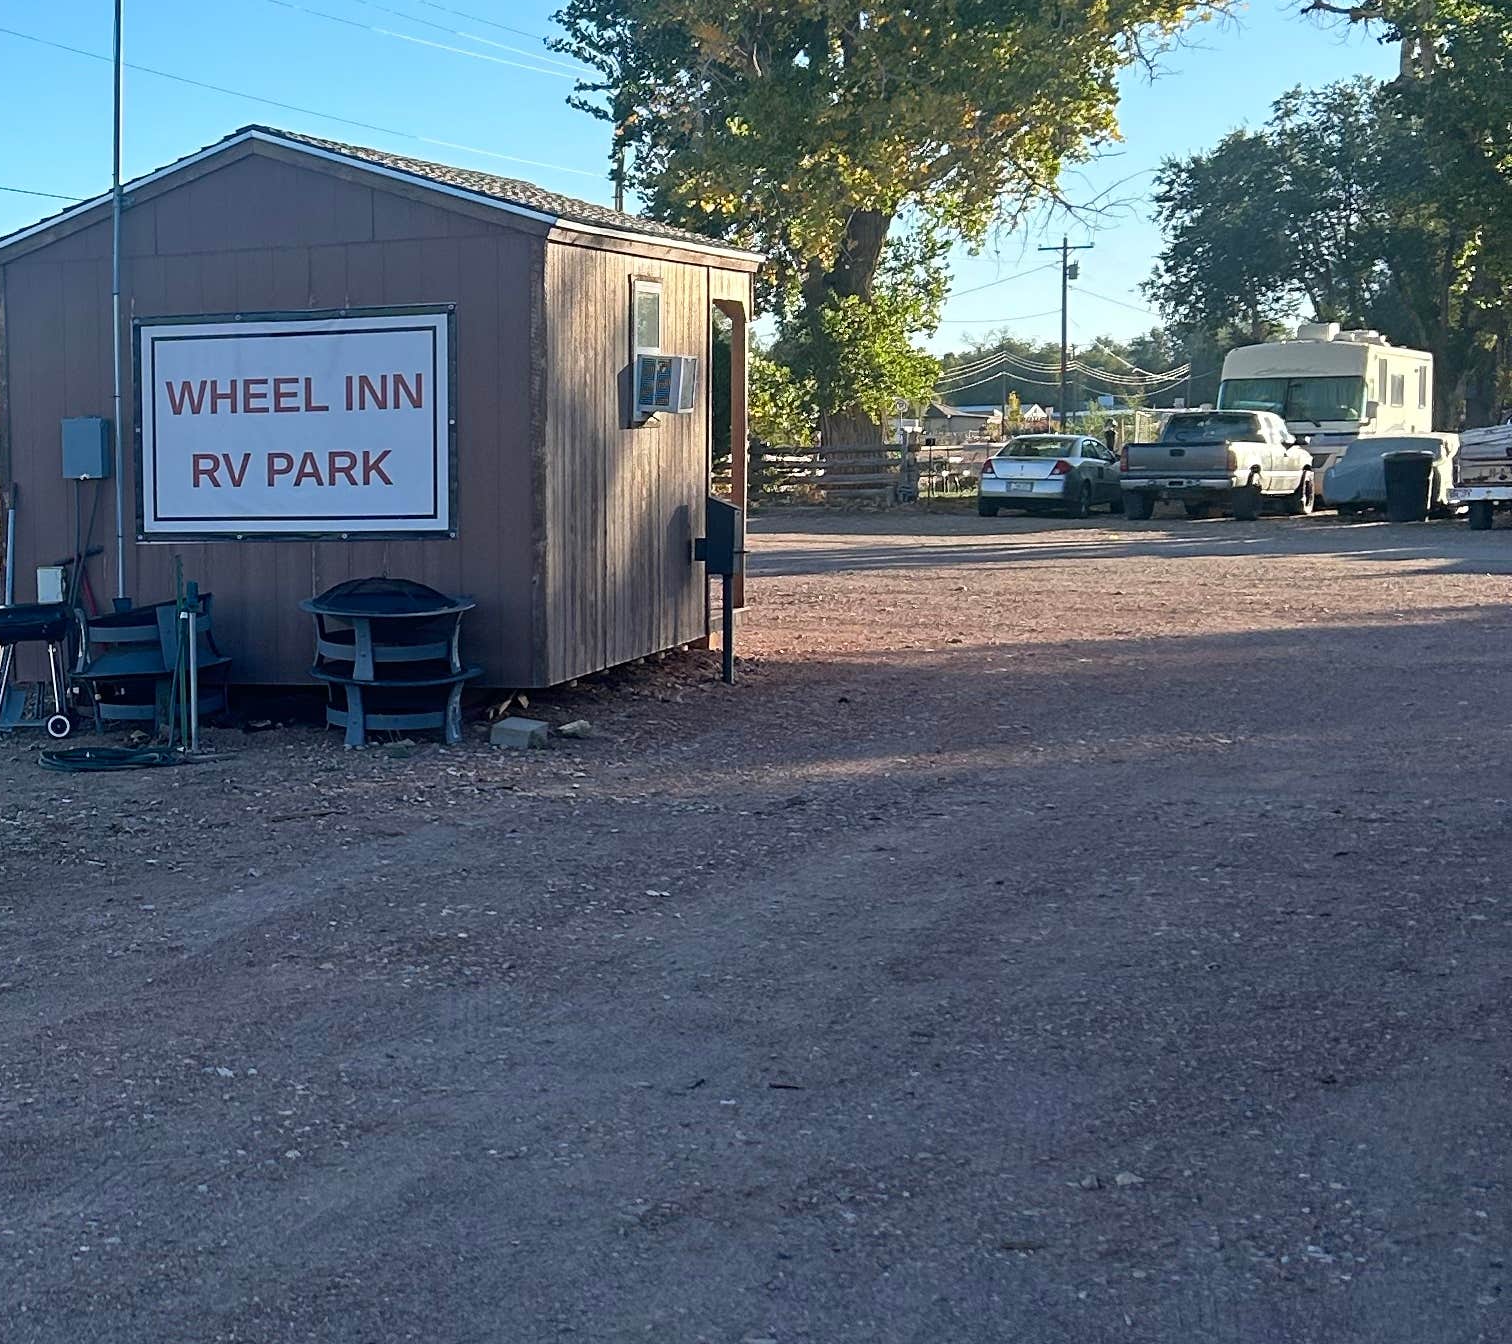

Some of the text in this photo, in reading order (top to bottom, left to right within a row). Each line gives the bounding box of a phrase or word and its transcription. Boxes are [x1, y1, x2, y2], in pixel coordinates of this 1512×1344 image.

[165, 372, 423, 416] WHEEL INN
[192, 449, 394, 489] RV PARK
